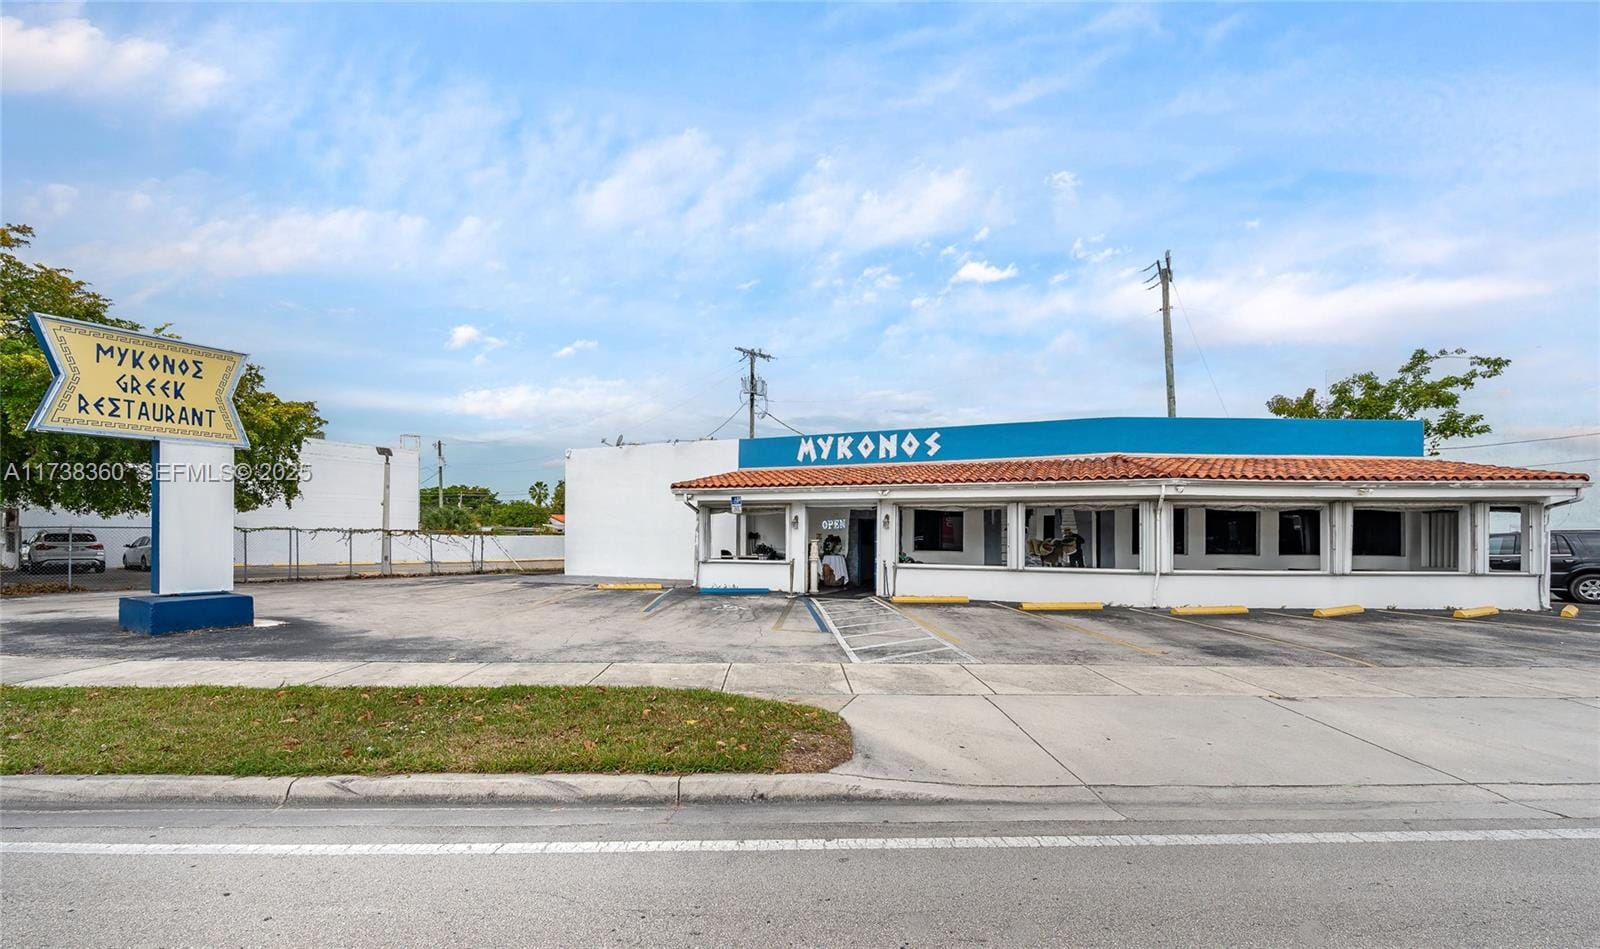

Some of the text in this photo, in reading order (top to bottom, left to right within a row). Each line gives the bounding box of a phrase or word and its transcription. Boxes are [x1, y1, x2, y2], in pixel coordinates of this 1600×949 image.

[116, 374, 186, 400] GREEK
[796, 431, 942, 463] MYKONOS
[822, 519, 846, 530] OPEN
